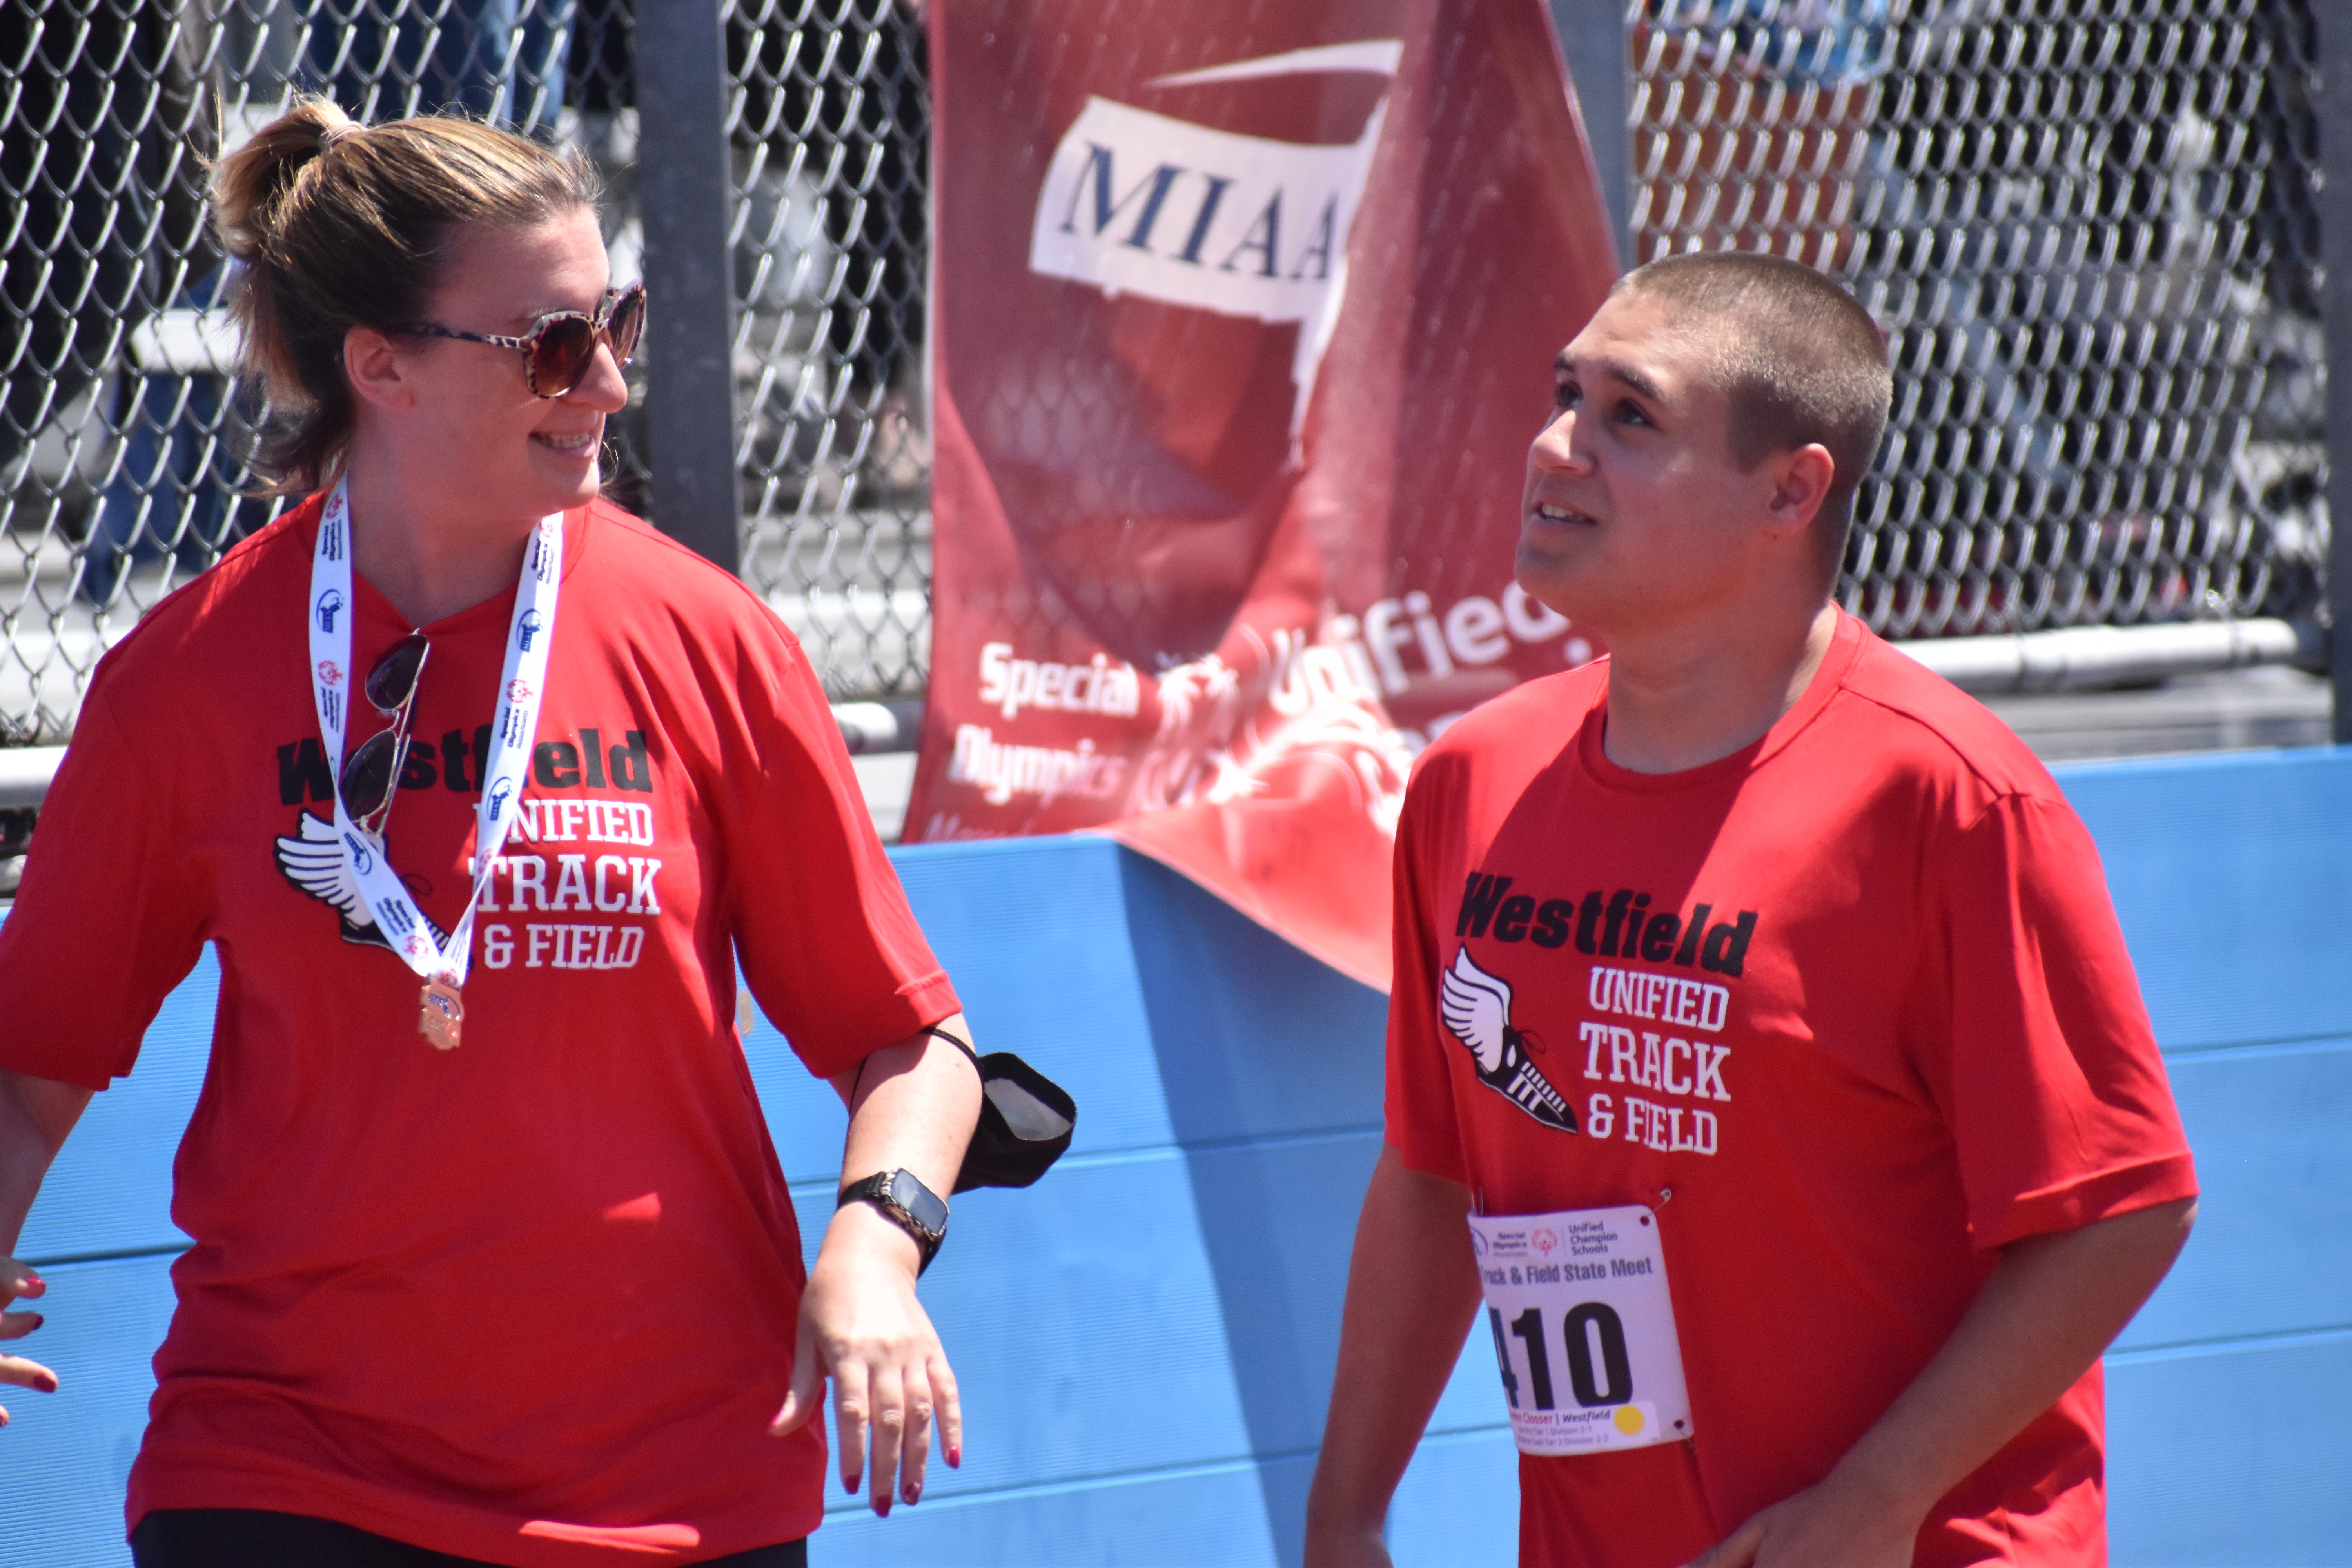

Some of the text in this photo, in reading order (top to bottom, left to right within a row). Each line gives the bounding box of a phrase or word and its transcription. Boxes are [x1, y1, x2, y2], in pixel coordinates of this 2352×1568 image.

[1058, 139, 1340, 281] MIAA
[531, 538, 541, 571] Special
[537, 542, 548, 581] Olympics
[979, 642, 1139, 720] Special
[500, 706, 510, 739] Special
[508, 708, 519, 747] Olympics
[517, 710, 528, 750] Massachusetts
[277, 725, 653, 805] Wstfeld
[947, 724, 1128, 809] Olympics
[473, 799, 653, 846] NIFIED
[468, 854, 661, 915] TRACK
[484, 924, 515, 969] &
[525, 923, 645, 969] FIELD
[1455, 871, 1758, 977] Westfield
[1589, 966, 1730, 1032] UNIFIED
[1580, 1022, 1731, 1101] TRACK
[1588, 1093, 1718, 1156] & FIELD
[1569, 1221, 1604, 1233] Unified
[1570, 1232, 1618, 1245] Champion
[1571, 1244, 1608, 1256] Schools
[1480, 1257, 1653, 1285] rack & Field State Meet
[1490, 1301, 1633, 1410] 410
[1563, 1409, 1611, 1423] Westfield
